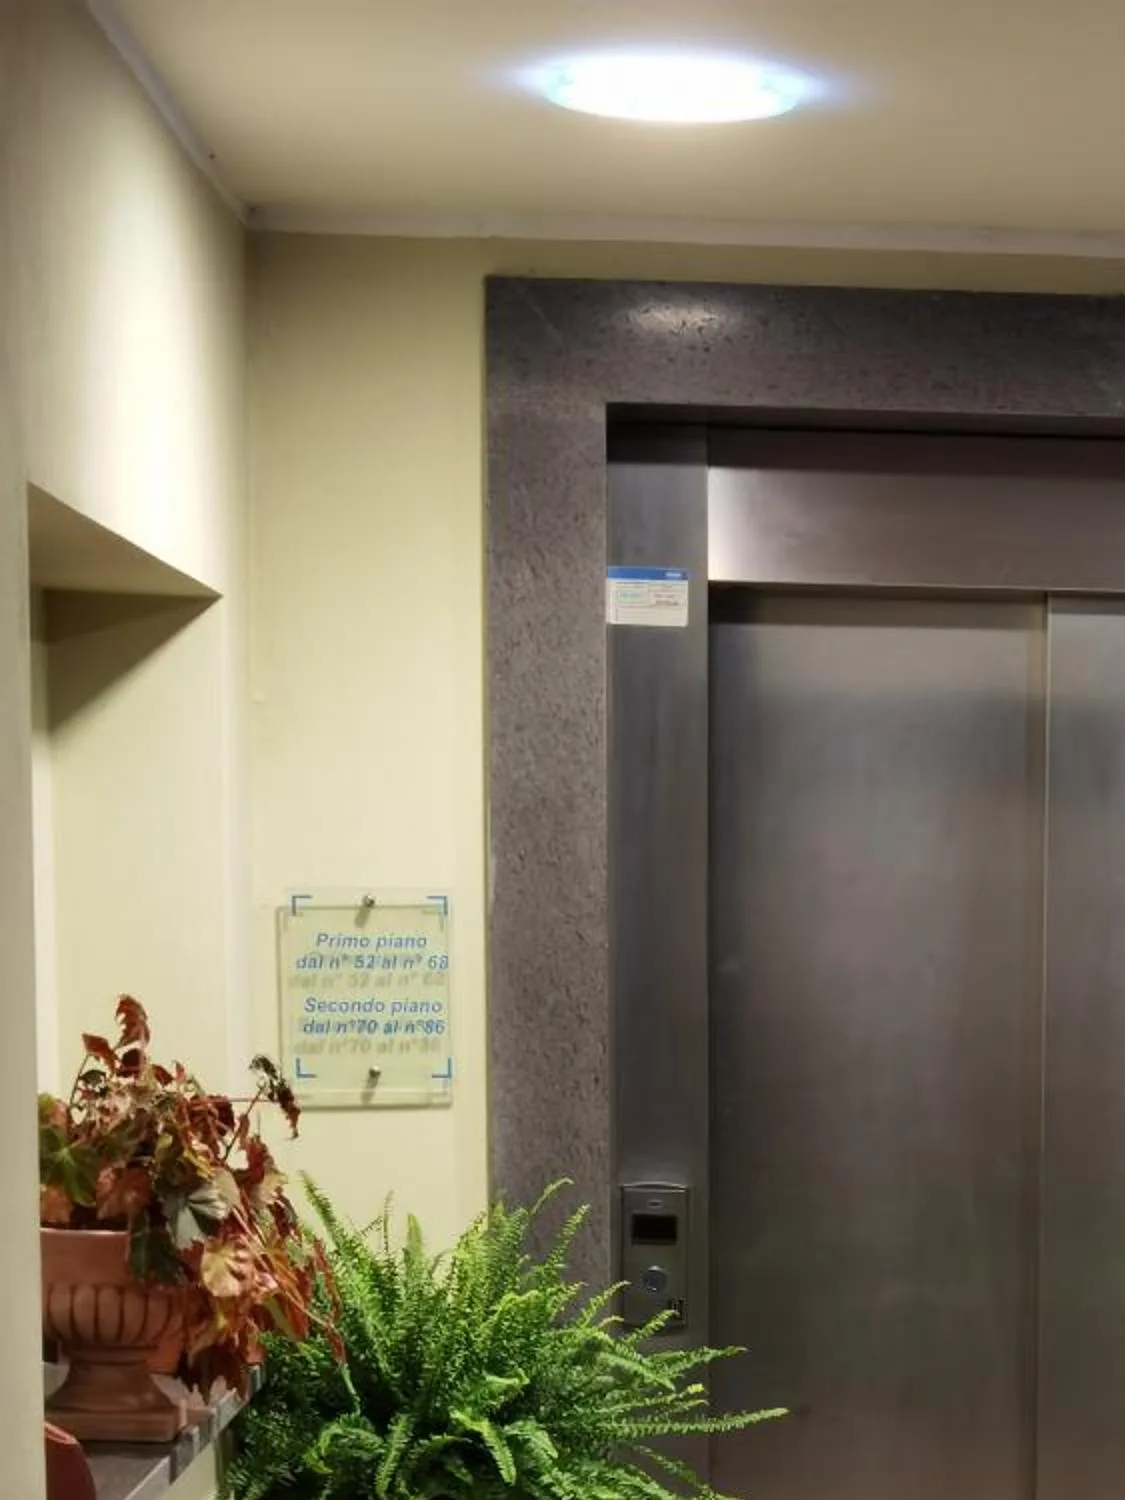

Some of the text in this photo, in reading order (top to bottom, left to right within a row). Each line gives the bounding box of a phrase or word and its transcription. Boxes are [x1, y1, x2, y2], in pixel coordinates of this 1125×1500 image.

[316, 933, 427, 951] Primo piano
[296, 955, 323, 970] dal
[354, 956, 374, 969] 52
[381, 955, 396, 969] al
[428, 955, 449, 969] 68
[305, 997, 443, 1016] Secondo piano
[303, 1020, 331, 1034] dal
[383, 1020, 398, 1034] al
